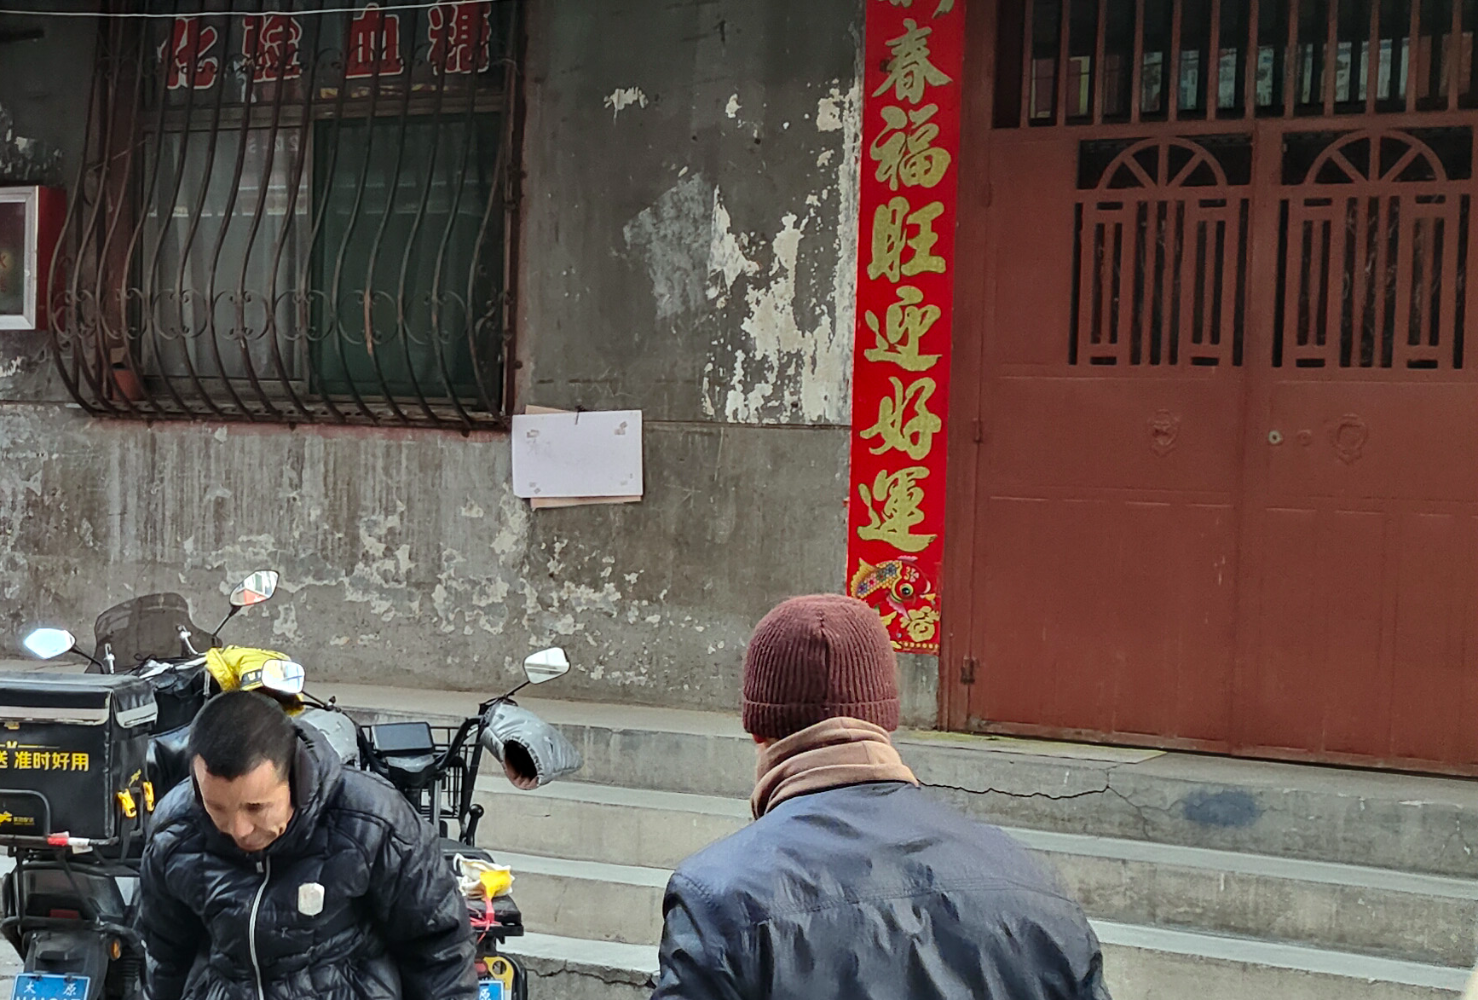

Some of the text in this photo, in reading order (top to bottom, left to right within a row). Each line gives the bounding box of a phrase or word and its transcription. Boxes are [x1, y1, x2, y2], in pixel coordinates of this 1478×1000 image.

[858, 0, 954, 553] 春福旺迎好運
[13, 750, 90, 772] 准时好用
